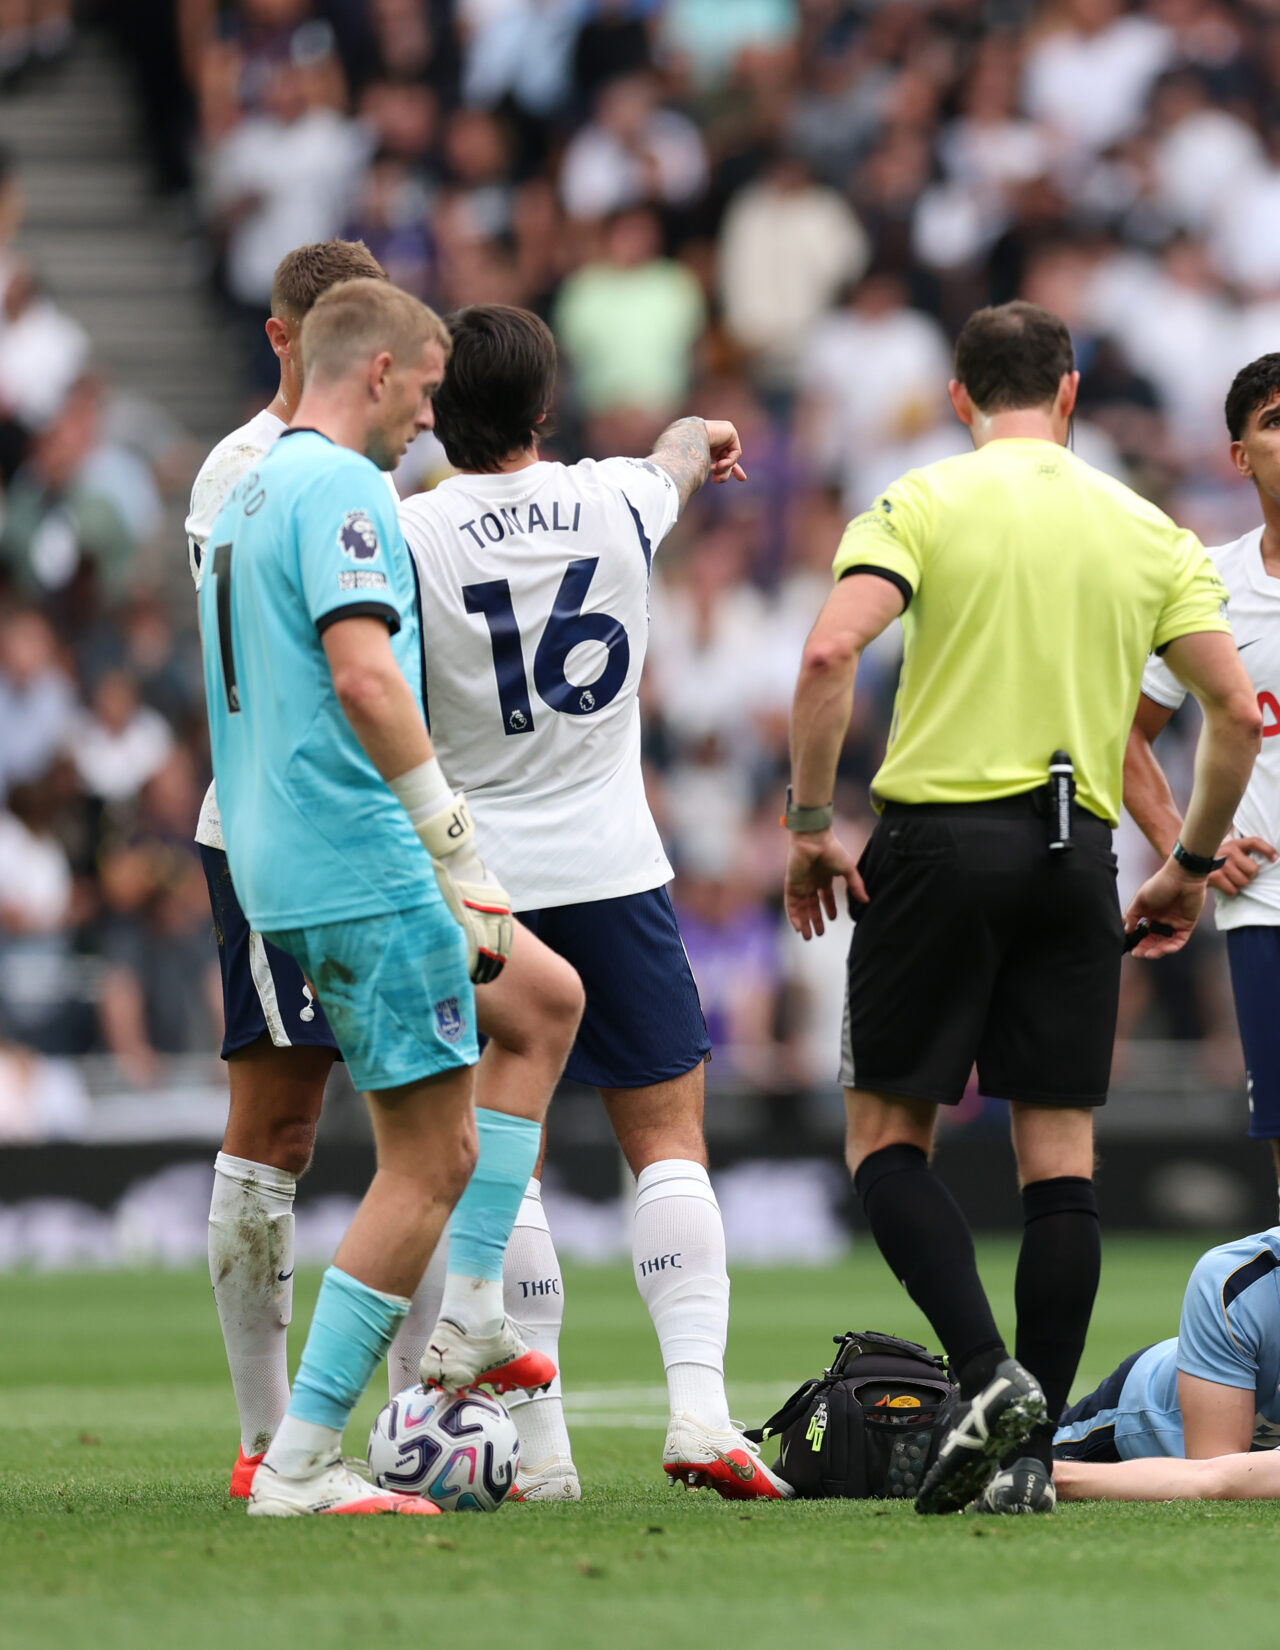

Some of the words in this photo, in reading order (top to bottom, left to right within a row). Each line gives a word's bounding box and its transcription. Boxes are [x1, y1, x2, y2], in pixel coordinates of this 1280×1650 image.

[459, 501, 581, 549] TONALI
[212, 543, 240, 715] 1
[462, 557, 630, 736] 16
[518, 1279, 560, 1299] THFC
[639, 1253, 682, 1277] THFC
